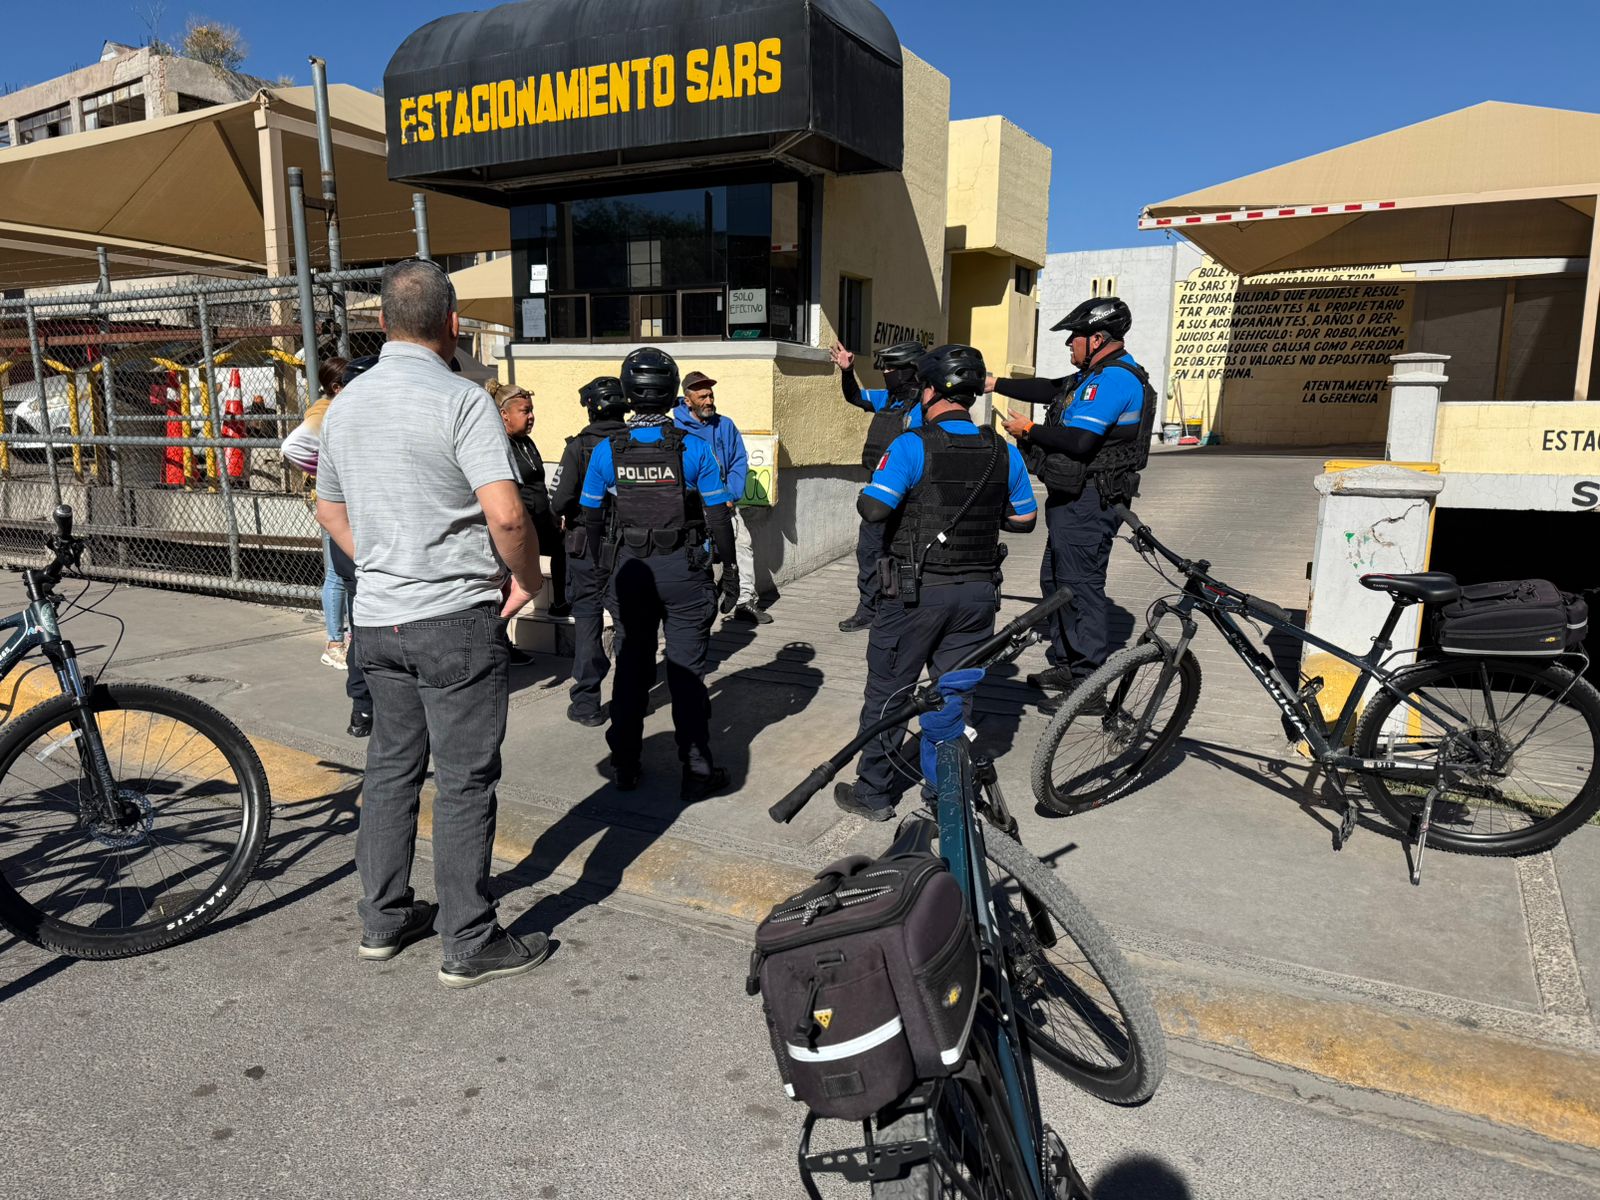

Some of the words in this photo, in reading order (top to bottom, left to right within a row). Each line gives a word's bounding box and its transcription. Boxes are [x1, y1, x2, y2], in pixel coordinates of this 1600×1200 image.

[400, 54, 675, 145] ESTACIONAMIENTO
[686, 37, 782, 104] SARS
[1199, 280, 1227, 291] SARS
[1230, 279, 1237, 290] Y
[732, 292, 754, 302] SOLO
[1179, 291, 1280, 305] RESPONSABILIDAD
[1284, 289, 1306, 301] QUE
[1309, 287, 1360, 300] PUDIESE
[1363, 285, 1406, 298] RESUL-
[729, 304, 763, 314] EFECTIVO
[1206, 305, 1232, 316] POR:
[1233, 303, 1303, 316] ACCIDENTES
[1306, 302, 1321, 313] AL
[1325, 300, 1405, 312] PROPIETARIO
[1088, 308, 1116, 325] POLICIA
[1177, 319, 1185, 329] A
[1187, 319, 1207, 329] SUS
[1312, 312, 1354, 326] DAÑOS
[1356, 314, 1365, 325] O
[1368, 312, 1397, 324] PER-
[873, 321, 914, 346] ENTRADA
[1176, 331, 1215, 342] JUICIOS
[1217, 331, 1230, 341] AL
[1296, 328, 1321, 339] POR
[1175, 344, 1195, 354] DIO
[1196, 344, 1204, 353] O
[1206, 342, 1269, 354] CUALQUIER
[1272, 341, 1310, 352] CAUSA
[1314, 341, 1348, 352] COMO
[1350, 339, 1405, 351] PERDIDA
[1239, 355, 1246, 365] O
[1249, 354, 1298, 366] VALORES
[1300, 354, 1316, 365] NO
[1318, 353, 1393, 365] DEPOSITADO
[1175, 369, 1189, 379] EN
[1191, 368, 1205, 379] LA
[1302, 380, 1389, 391] ATENTAMENTE
[1302, 393, 1316, 403] LA
[1319, 393, 1379, 404] GERENCIA
[1542, 429, 1600, 452] ESTA
[616, 466, 675, 480] POLICIA
[165, 883, 228, 932] MAXXIS
